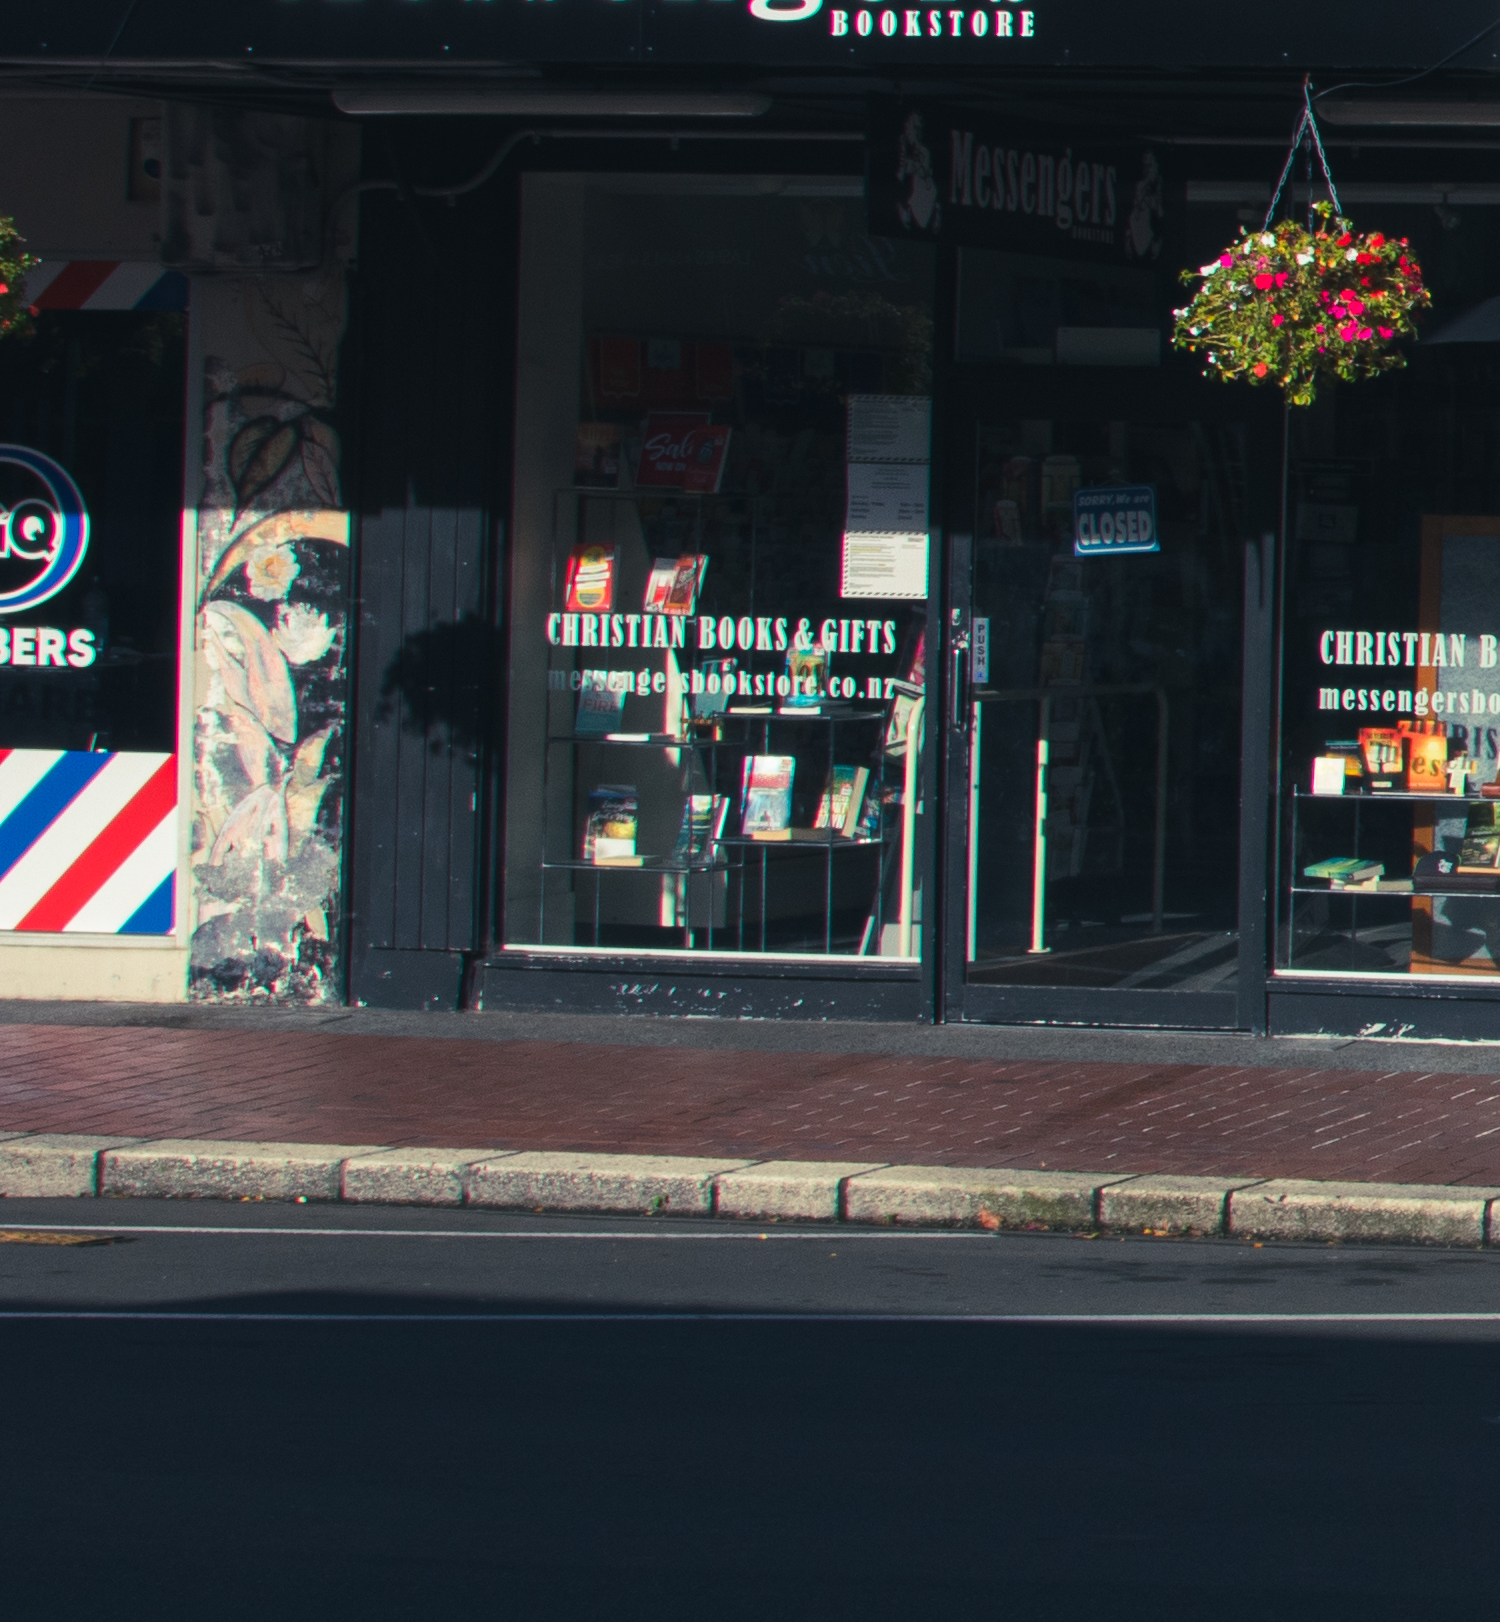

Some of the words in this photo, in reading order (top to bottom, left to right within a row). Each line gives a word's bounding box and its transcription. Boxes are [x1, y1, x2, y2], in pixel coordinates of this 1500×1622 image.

[831, 8, 1036, 37] BOOKSTORE
[950, 129, 1117, 229] Messengers
[1078, 510, 1151, 546] CLOSED
[547, 613, 688, 649] CHRISTIAN
[697, 615, 789, 652] BOOKS
[793, 617, 815, 650] &
[820, 618, 897, 654] GIFTS
[977, 625, 986, 666] PUSH
[1320, 630, 1466, 669] CHRISTIAN
[547, 668, 896, 700] messengesbookstore.co.nz
